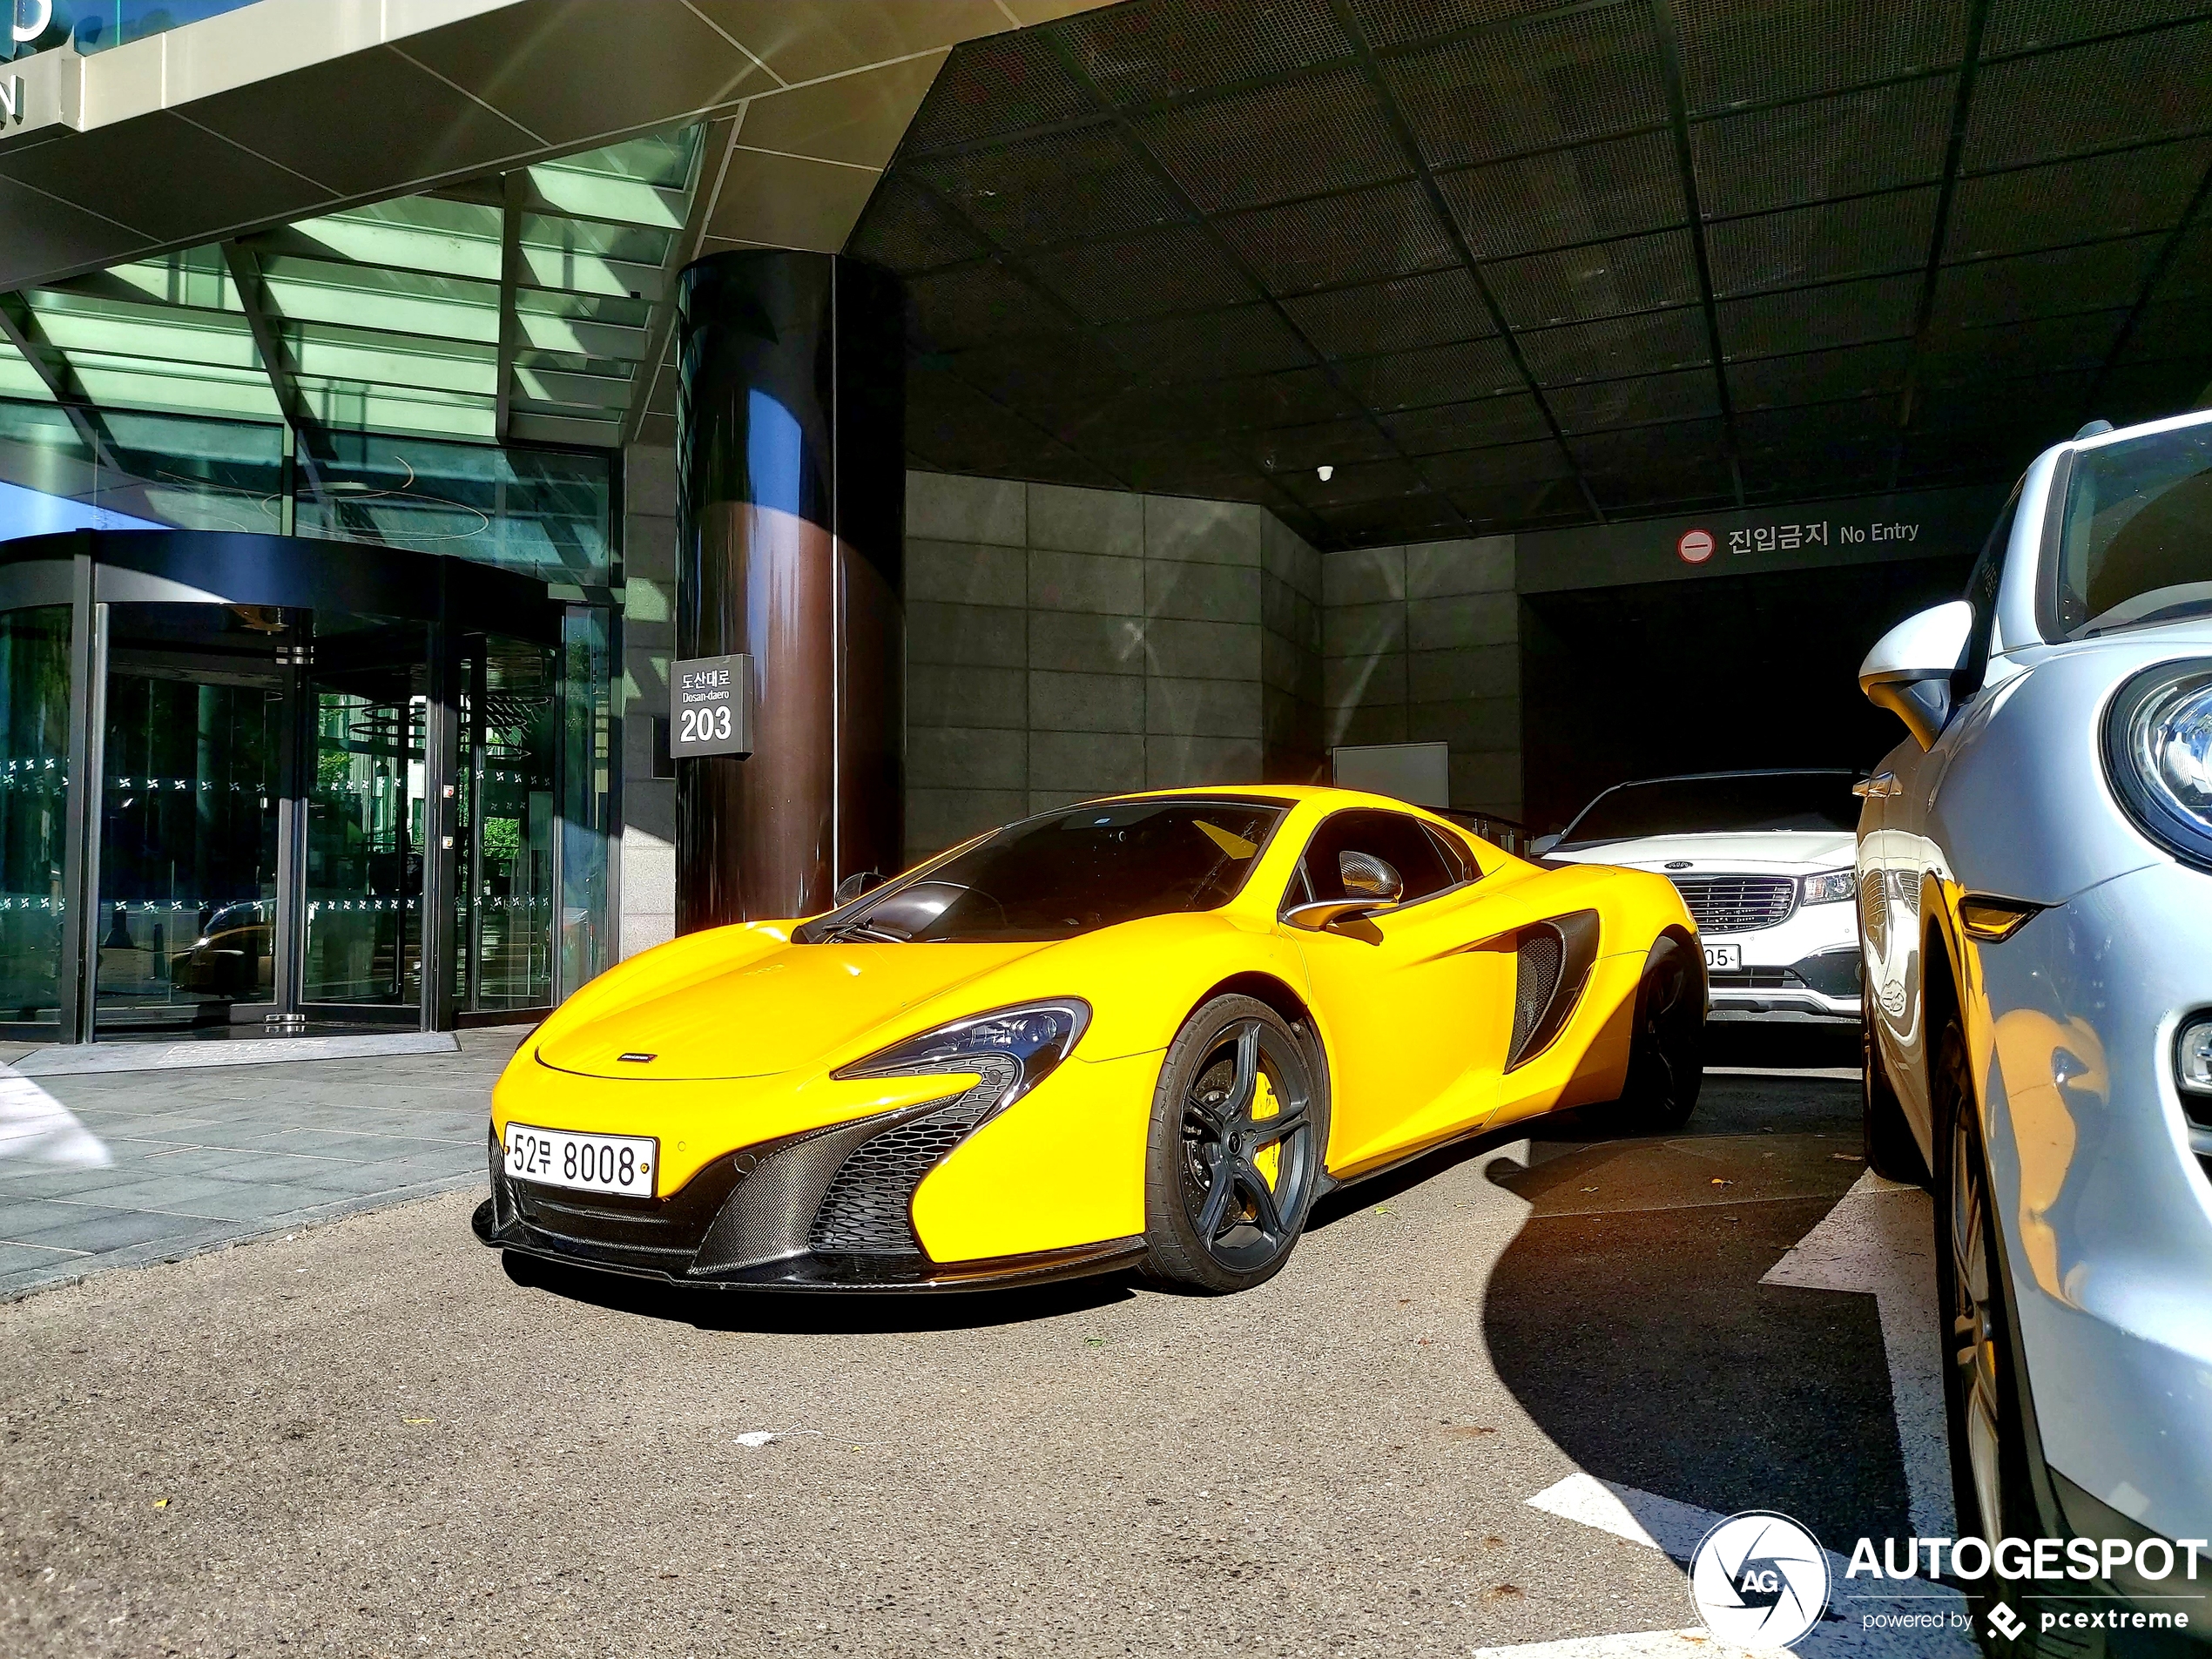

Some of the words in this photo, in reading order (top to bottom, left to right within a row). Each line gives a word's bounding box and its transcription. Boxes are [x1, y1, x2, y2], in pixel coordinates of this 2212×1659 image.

[1729, 521, 1828, 555] 진입금지
[1840, 525, 1865, 544] No
[1871, 523, 1919, 542] Entry
[681, 670, 731, 689] 도산대로
[682, 690, 730, 704] Dosan-daero
[680, 705, 732, 742] 203
[514, 1134, 550, 1174] 52무
[564, 1142, 635, 1186] 8008
